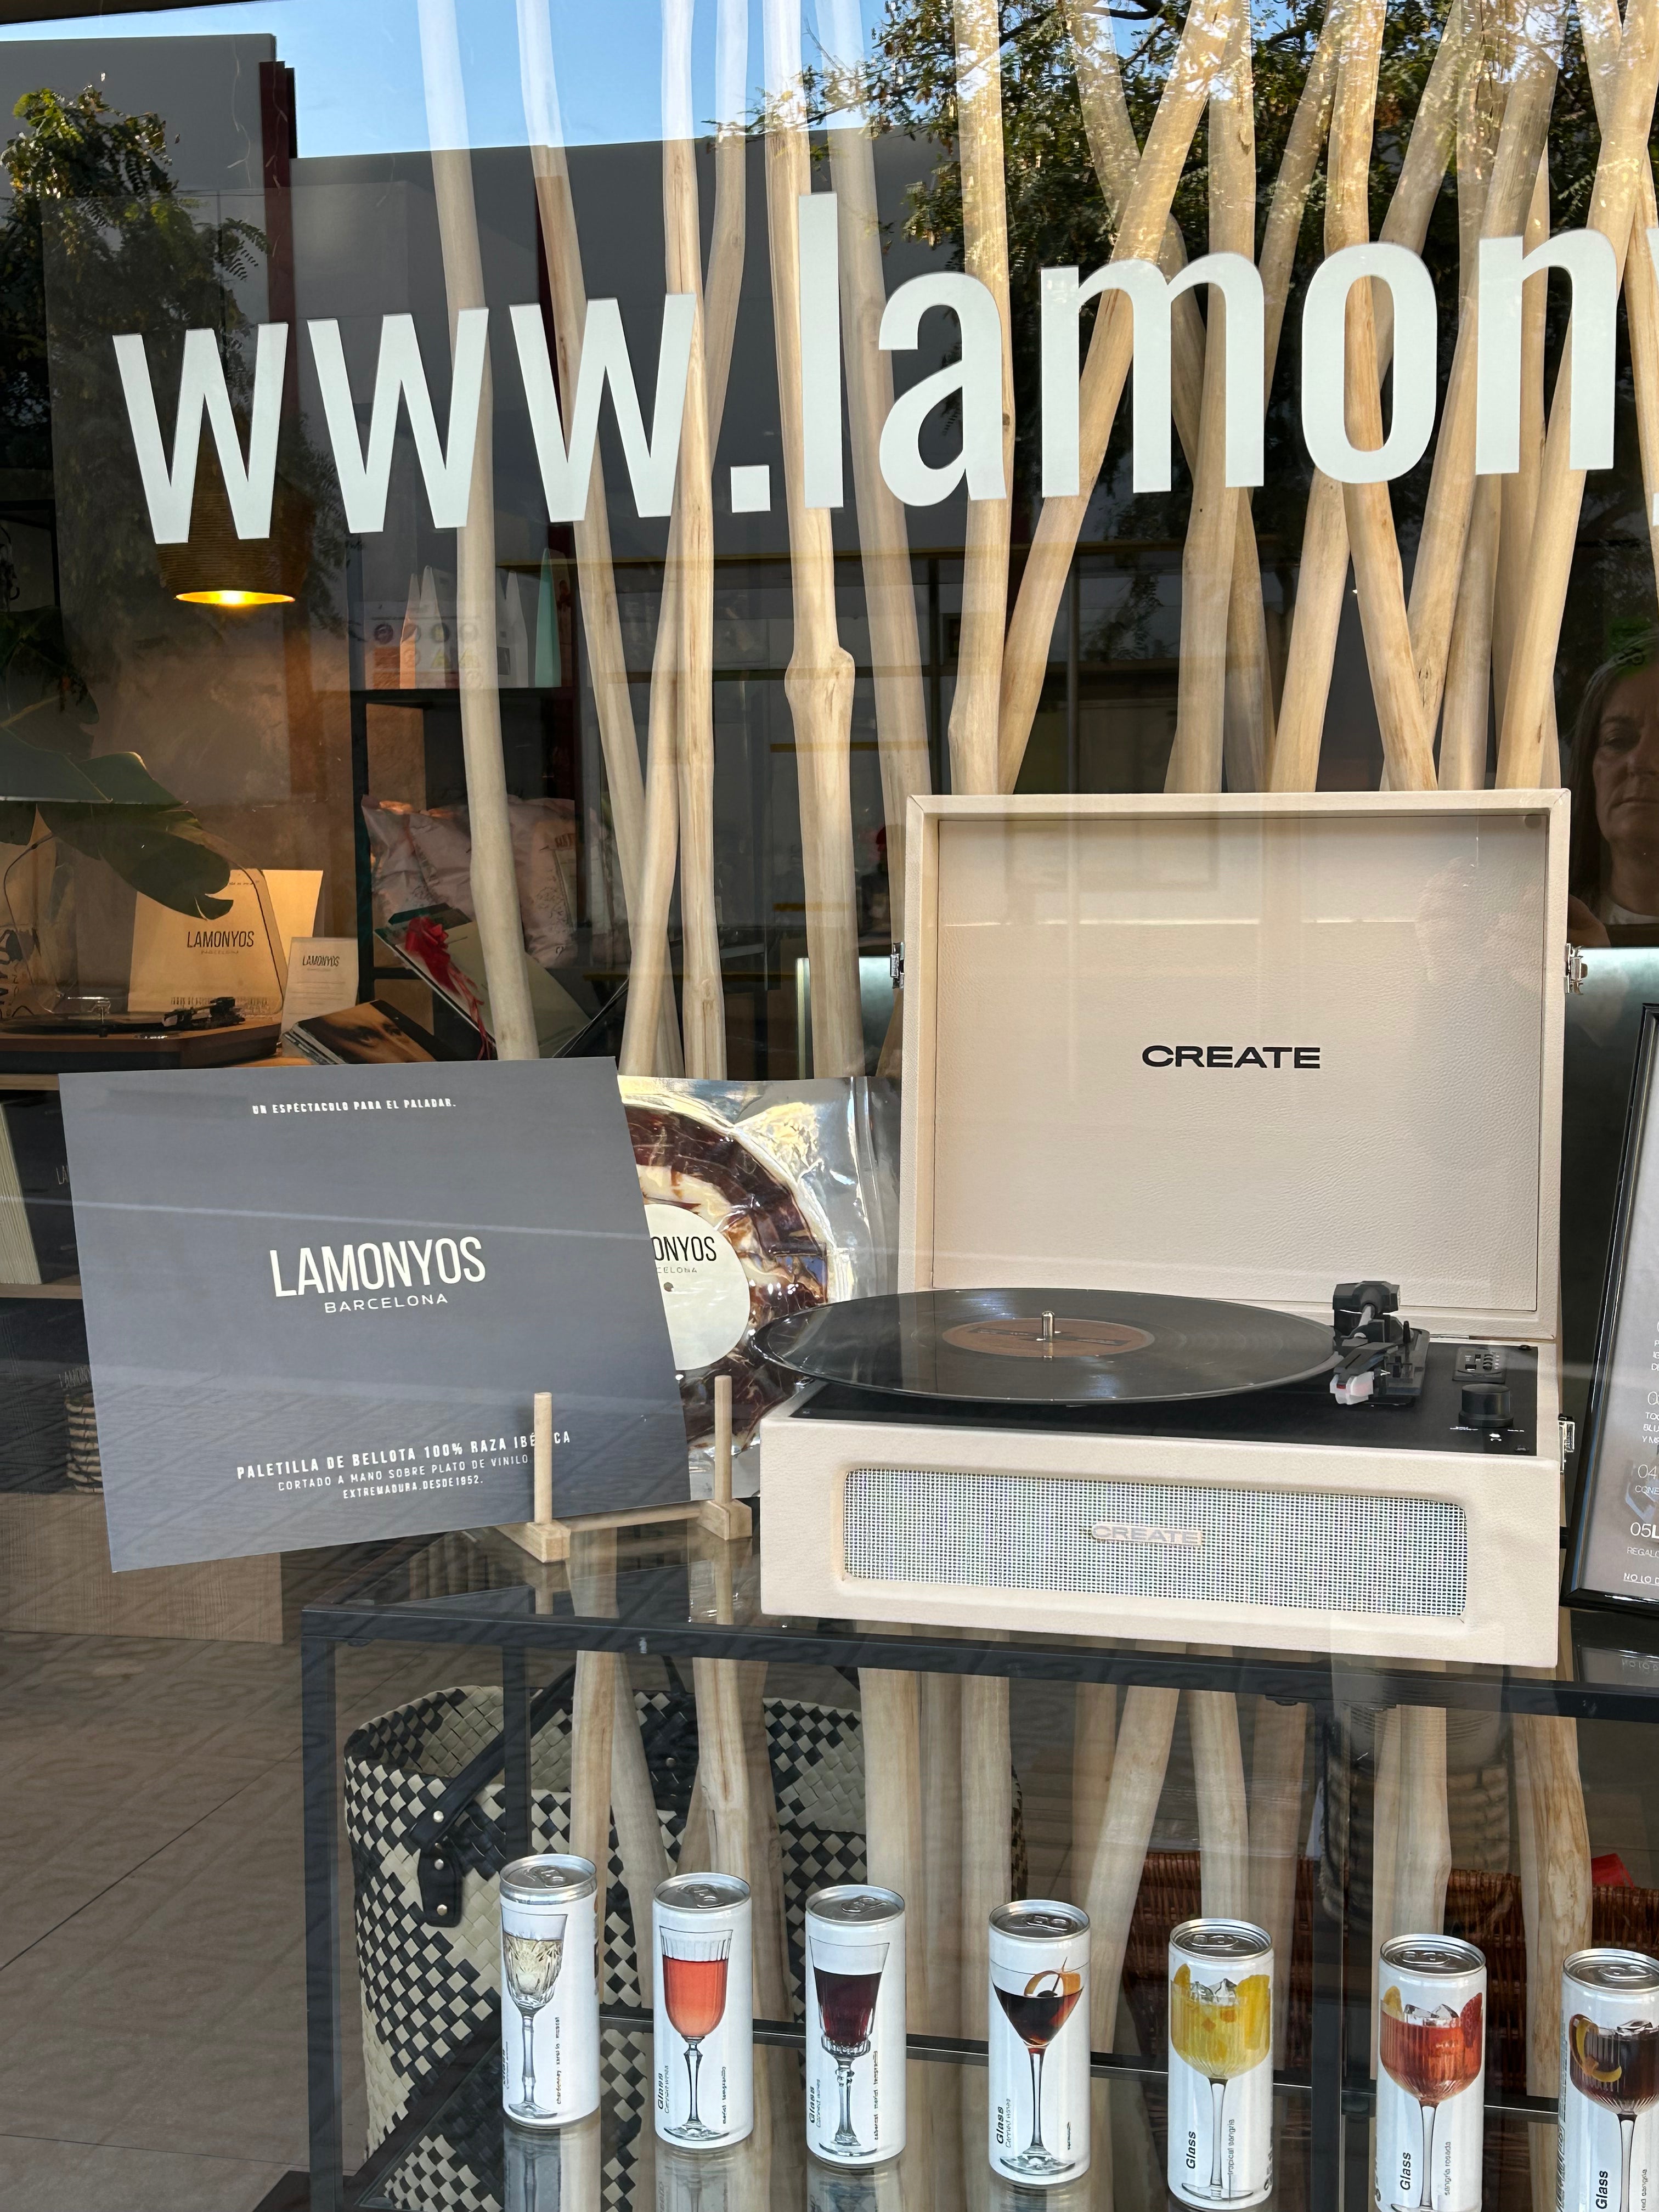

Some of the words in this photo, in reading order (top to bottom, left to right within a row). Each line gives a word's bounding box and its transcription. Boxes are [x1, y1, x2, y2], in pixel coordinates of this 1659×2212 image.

[112, 192, 1659, 544] www.lamon
[187, 931, 255, 948] LAMONYOS
[302, 955, 340, 967] LAMONYOS
[1142, 1045, 1321, 1069] CREATE
[252, 1105, 268, 1114] UN
[353, 1101, 382, 1111] PARA
[386, 1100, 399, 1109] EL
[651, 1236, 717, 1261] ONYOS
[269, 1236, 487, 1297] LAMONYOS
[324, 1293, 449, 1313] BARCELONA
[236, 1458, 319, 1480] PALETILLA
[326, 1455, 345, 1470] DE
[352, 1447, 416, 1467] BELLOTA
[424, 1443, 463, 1459] 100%
[470, 1438, 507, 1453] RAZA
[514, 1431, 571, 1449] IBÉCA
[278, 1476, 331, 1491] CORTADO
[337, 1475, 345, 1484] A
[350, 1470, 382, 1483] MANO
[388, 1465, 425, 1479] SOBRE
[432, 1461, 466, 1474] PLATO
[472, 1459, 486, 1470] DE
[1092, 1525, 1199, 1544] CREATE
[996, 2106, 1005, 2145] Glass
[1186, 2131, 1197, 2169] Glass
[1227, 2148, 1236, 2175] tropical
[1400, 2152, 1412, 2191] Glass
[1595, 2170, 1609, 2210] Glass
